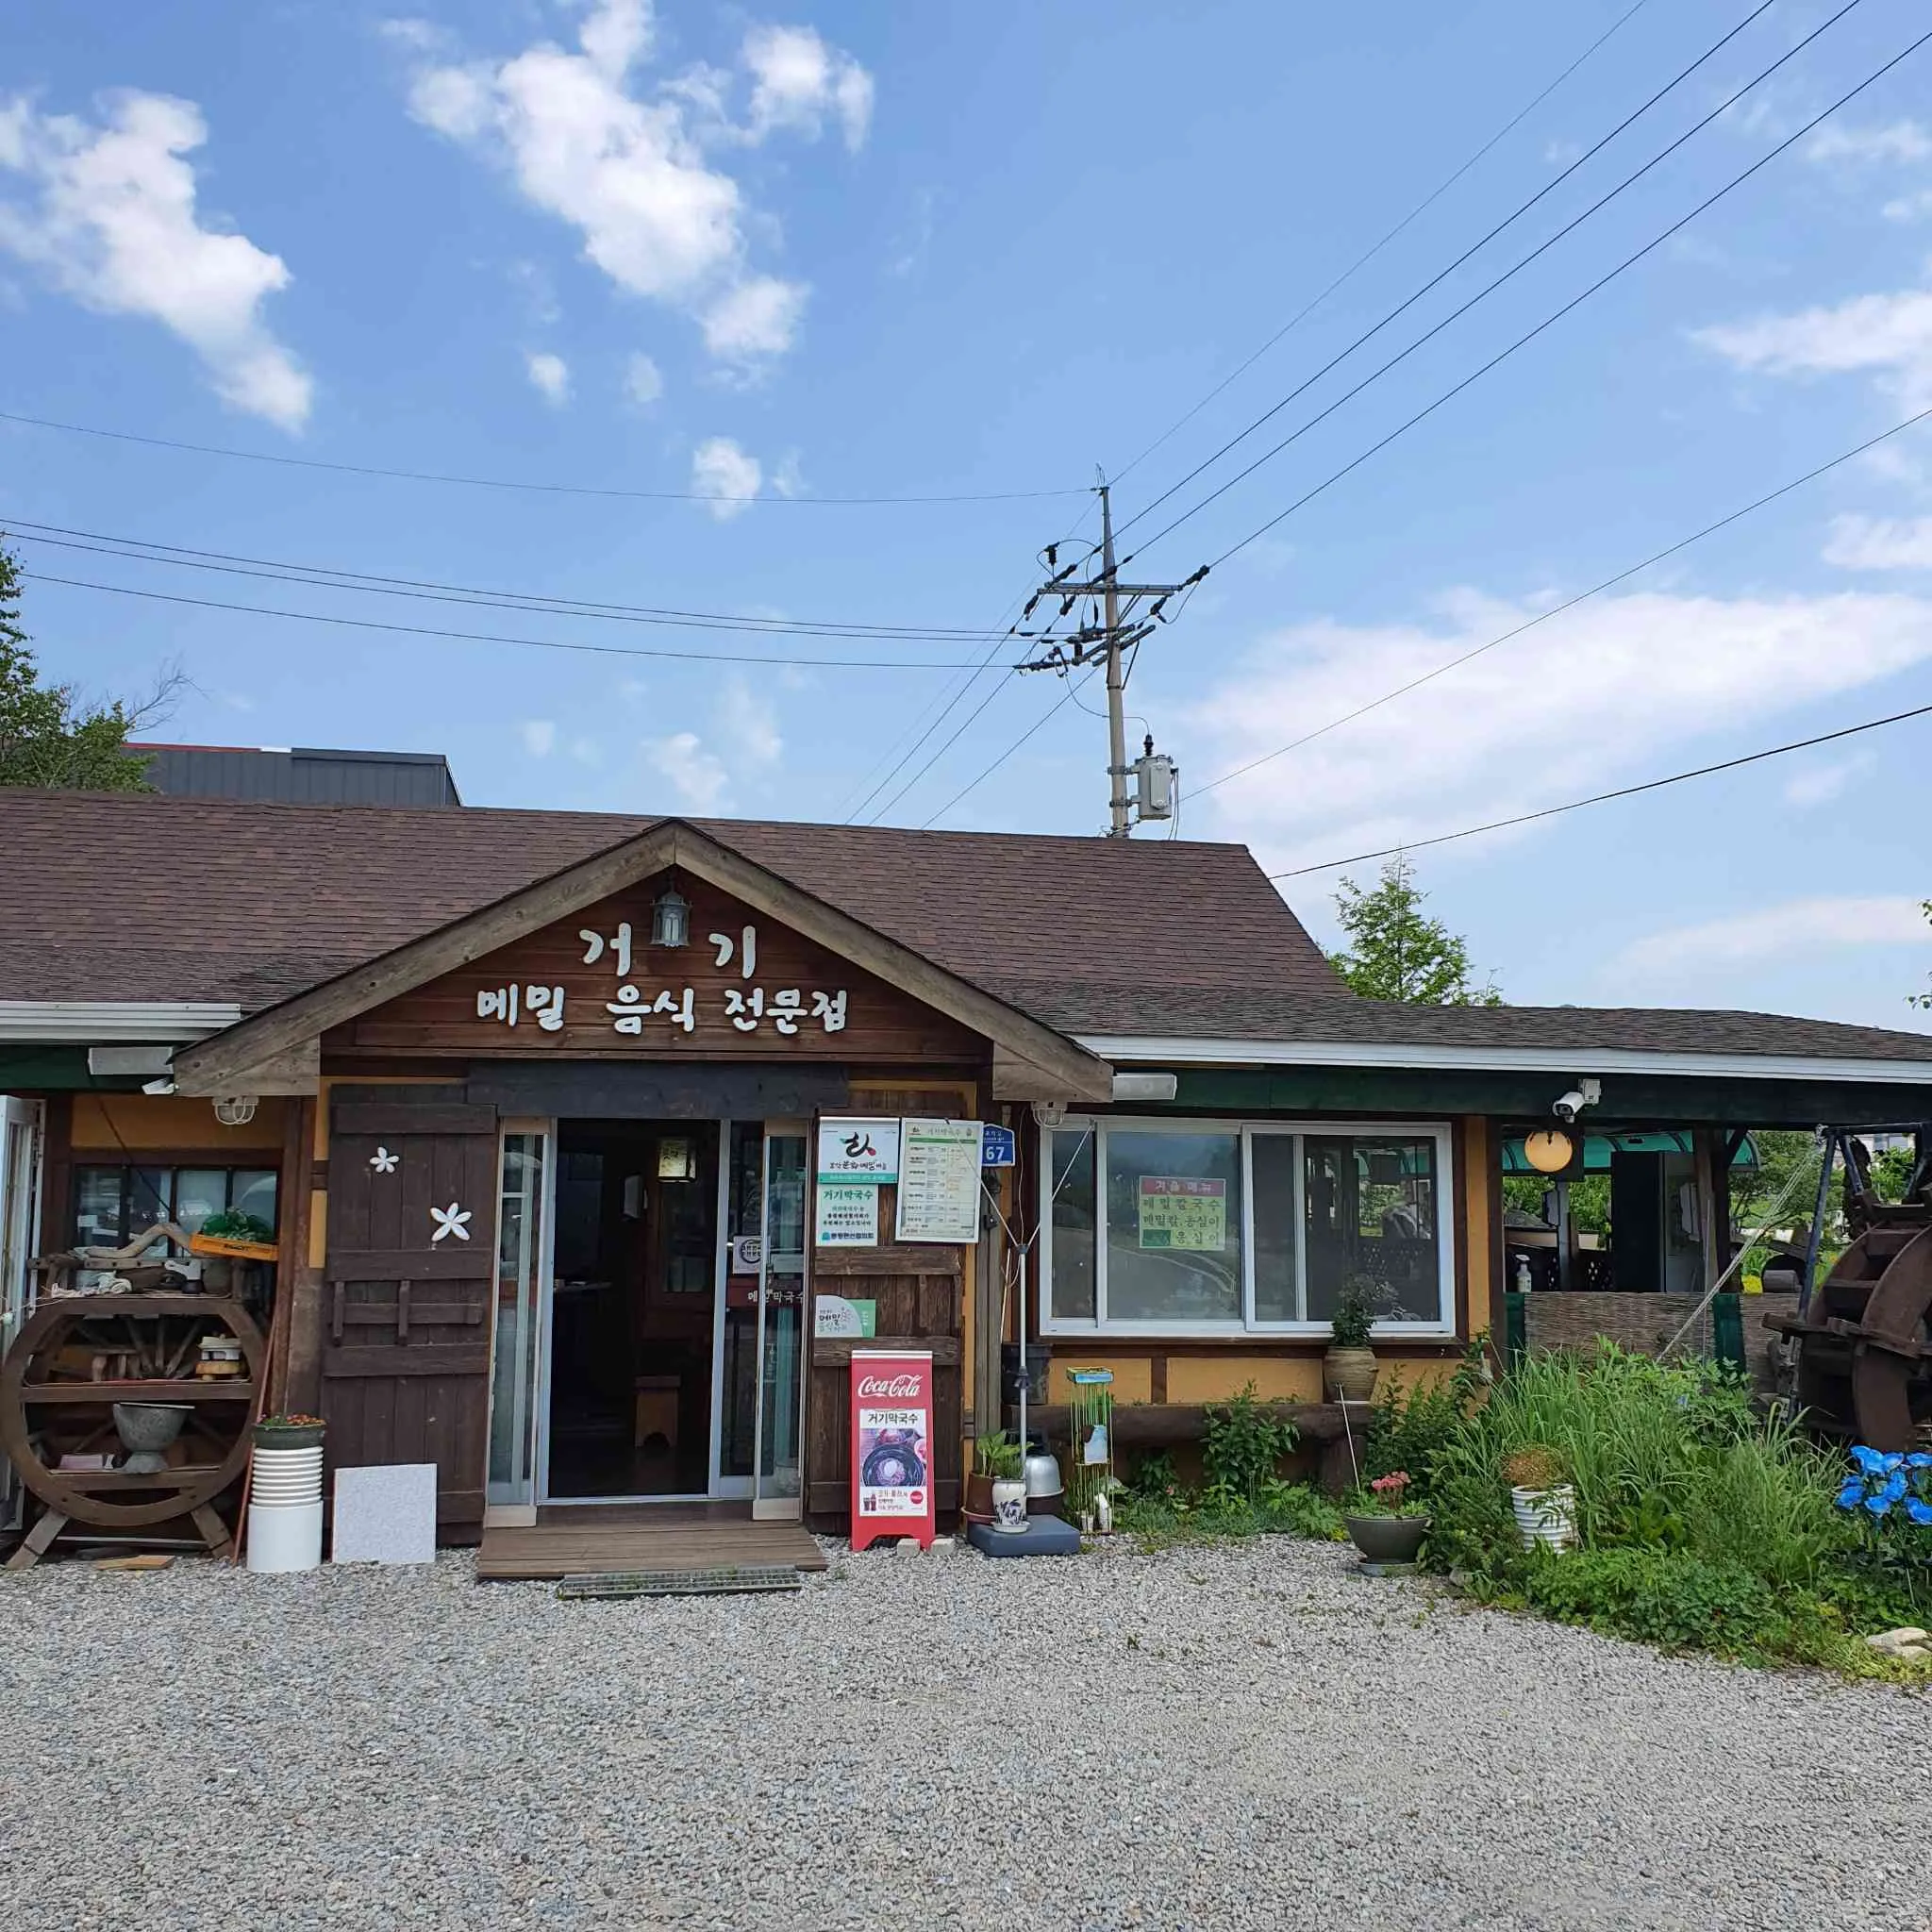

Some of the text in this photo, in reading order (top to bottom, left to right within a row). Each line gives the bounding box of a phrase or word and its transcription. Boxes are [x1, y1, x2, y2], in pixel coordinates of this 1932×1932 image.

[476, 983, 848, 1035] 메밀 음식 전문점
[986, 1145, 1005, 1160] 67
[823, 1189, 874, 1201] 거기막국수
[858, 1374, 924, 1398] Coca-Cola
[868, 1411, 919, 1425] 거기막국수
